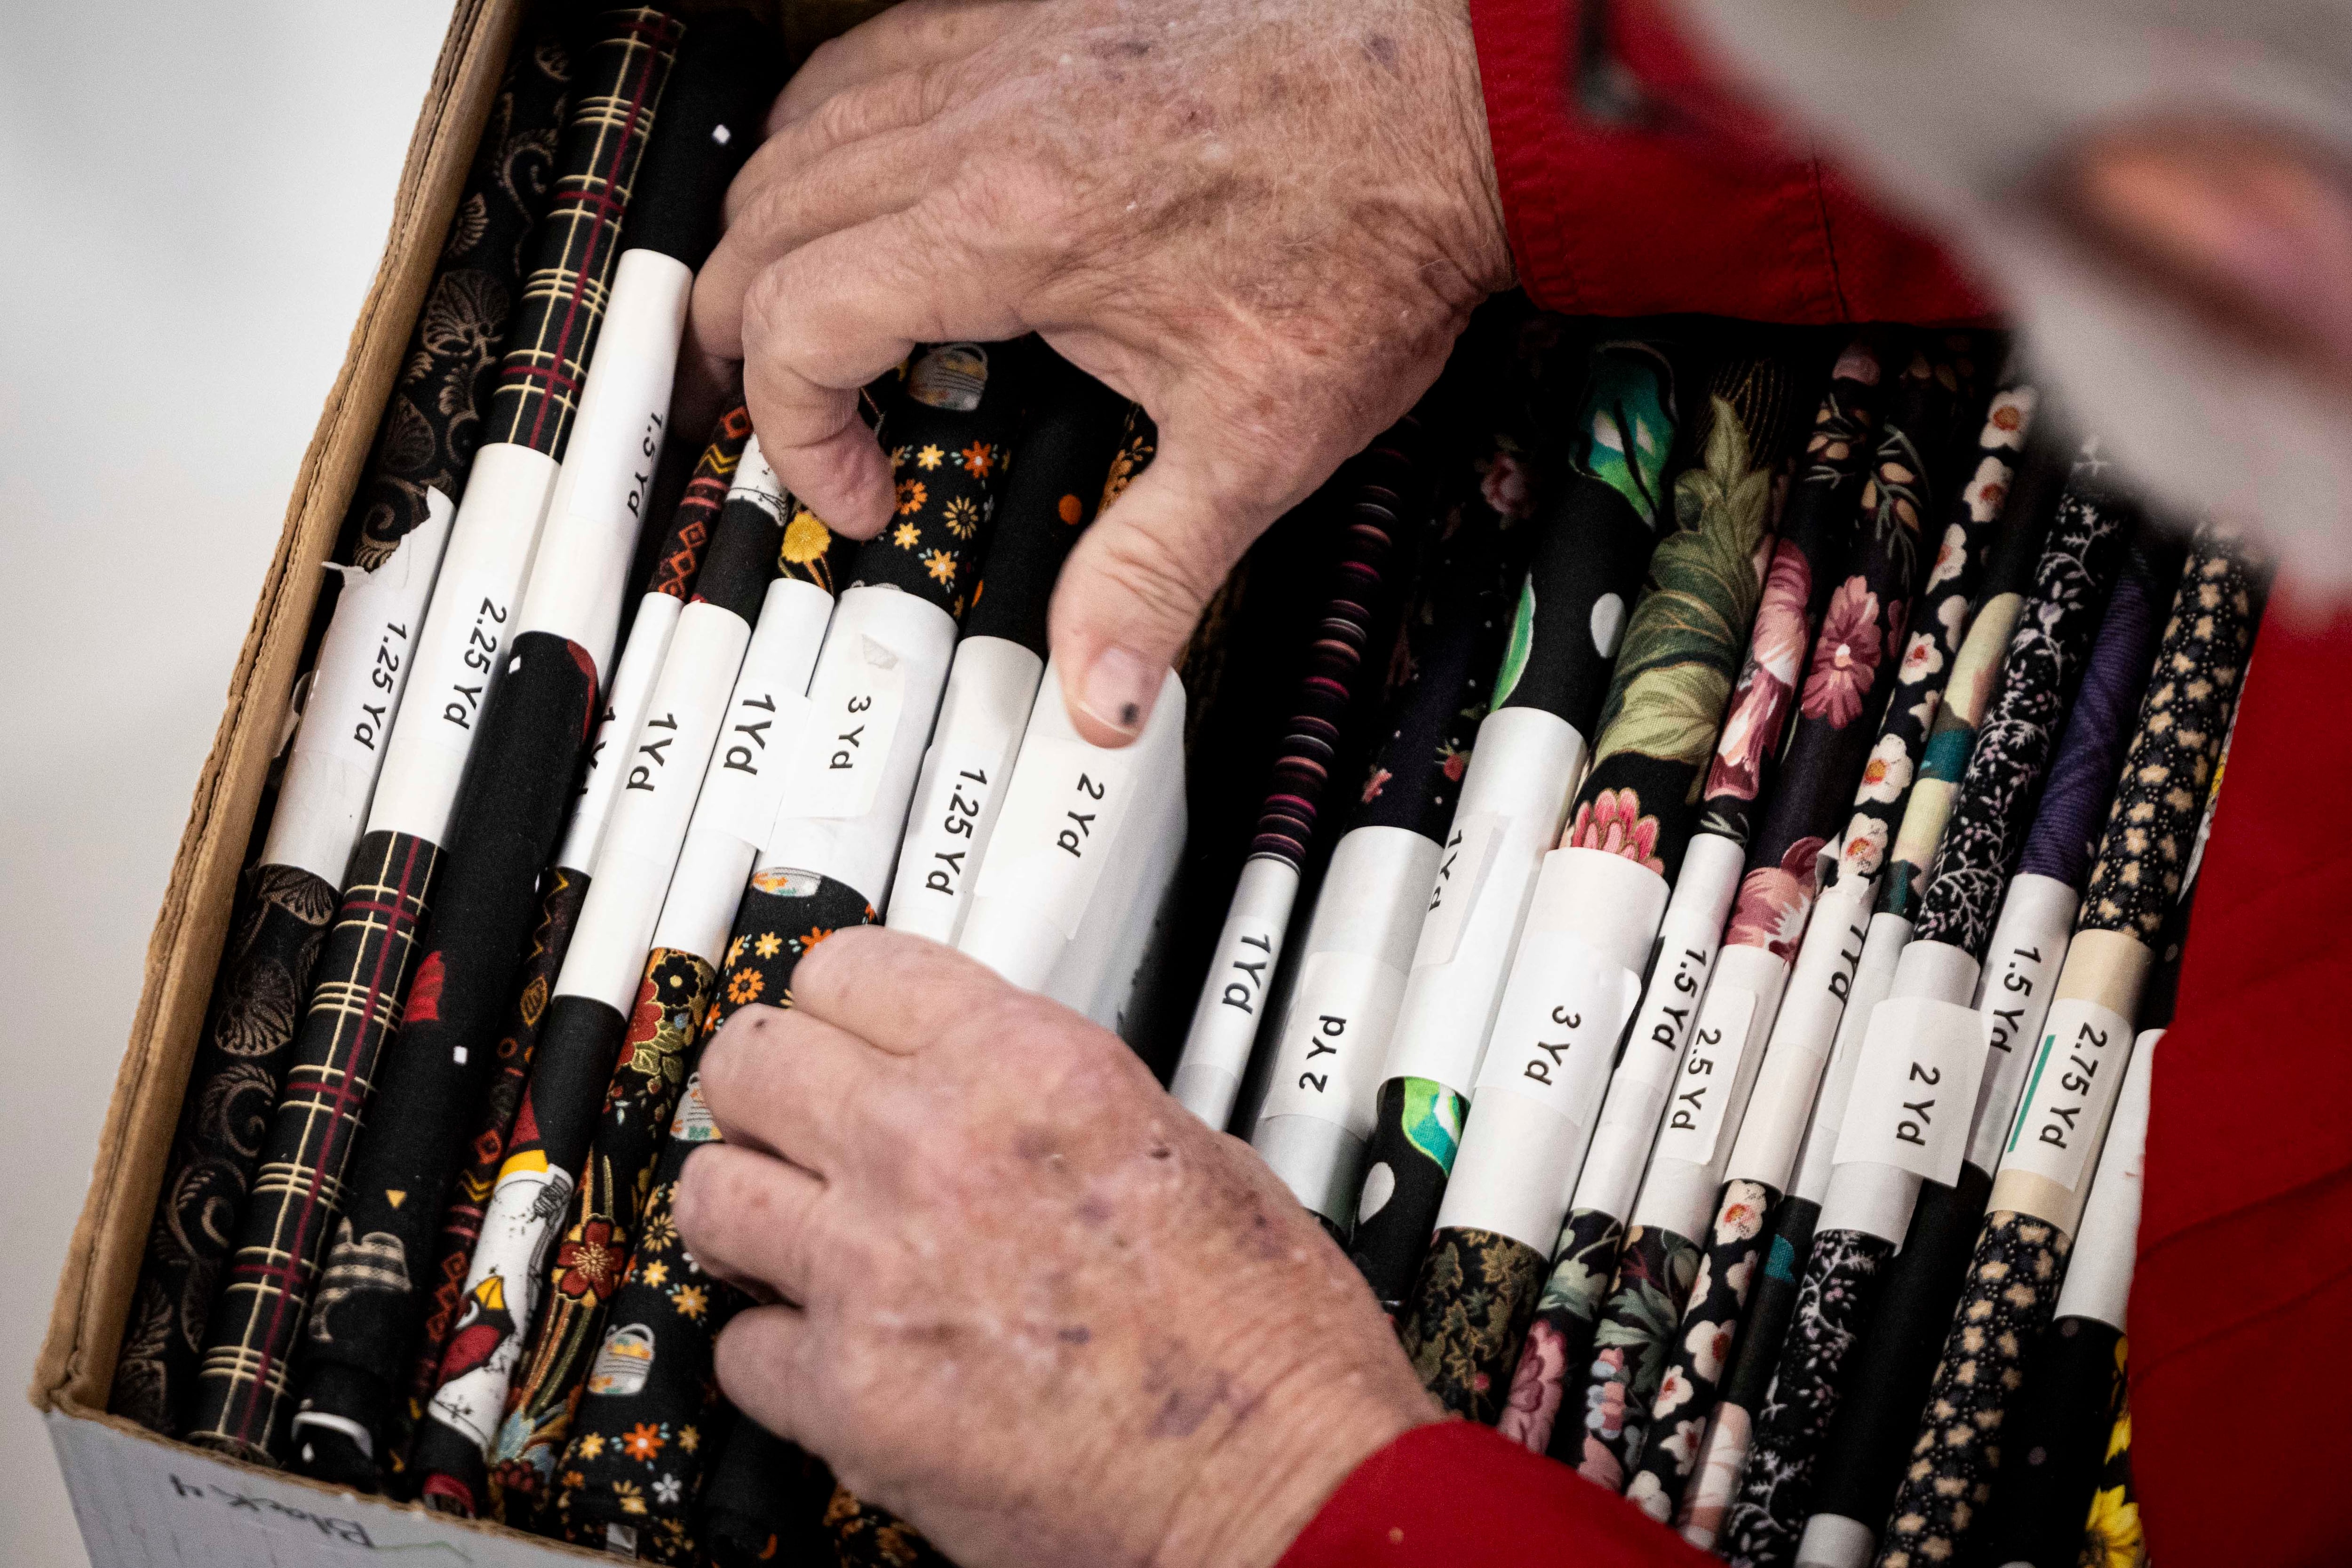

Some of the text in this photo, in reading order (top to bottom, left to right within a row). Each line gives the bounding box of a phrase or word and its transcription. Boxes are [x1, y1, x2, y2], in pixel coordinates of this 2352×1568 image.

[627, 413, 662, 517] 1.5 Yd
[354, 623, 406, 750] 1.25 Yd
[444, 598, 507, 730] 2.25 Yd
[830, 697, 871, 769] 3 Yd
[926, 770, 987, 895] 1.25 Yd
[1057, 774, 1104, 858] 2 Yd
[1525, 1006, 1581, 1085] 3 Yd
[1652, 950, 1706, 1051] 1.5 Yd
[1990, 947, 2042, 1053] 1.5 Yd
[1299, 1016, 1346, 1092] 2 Yd
[1670, 1029, 1721, 1130] 2.5 Yd
[1896, 1062, 1940, 1146] 2 Yd
[2039, 1023, 2108, 1149] 2.75 Yd
